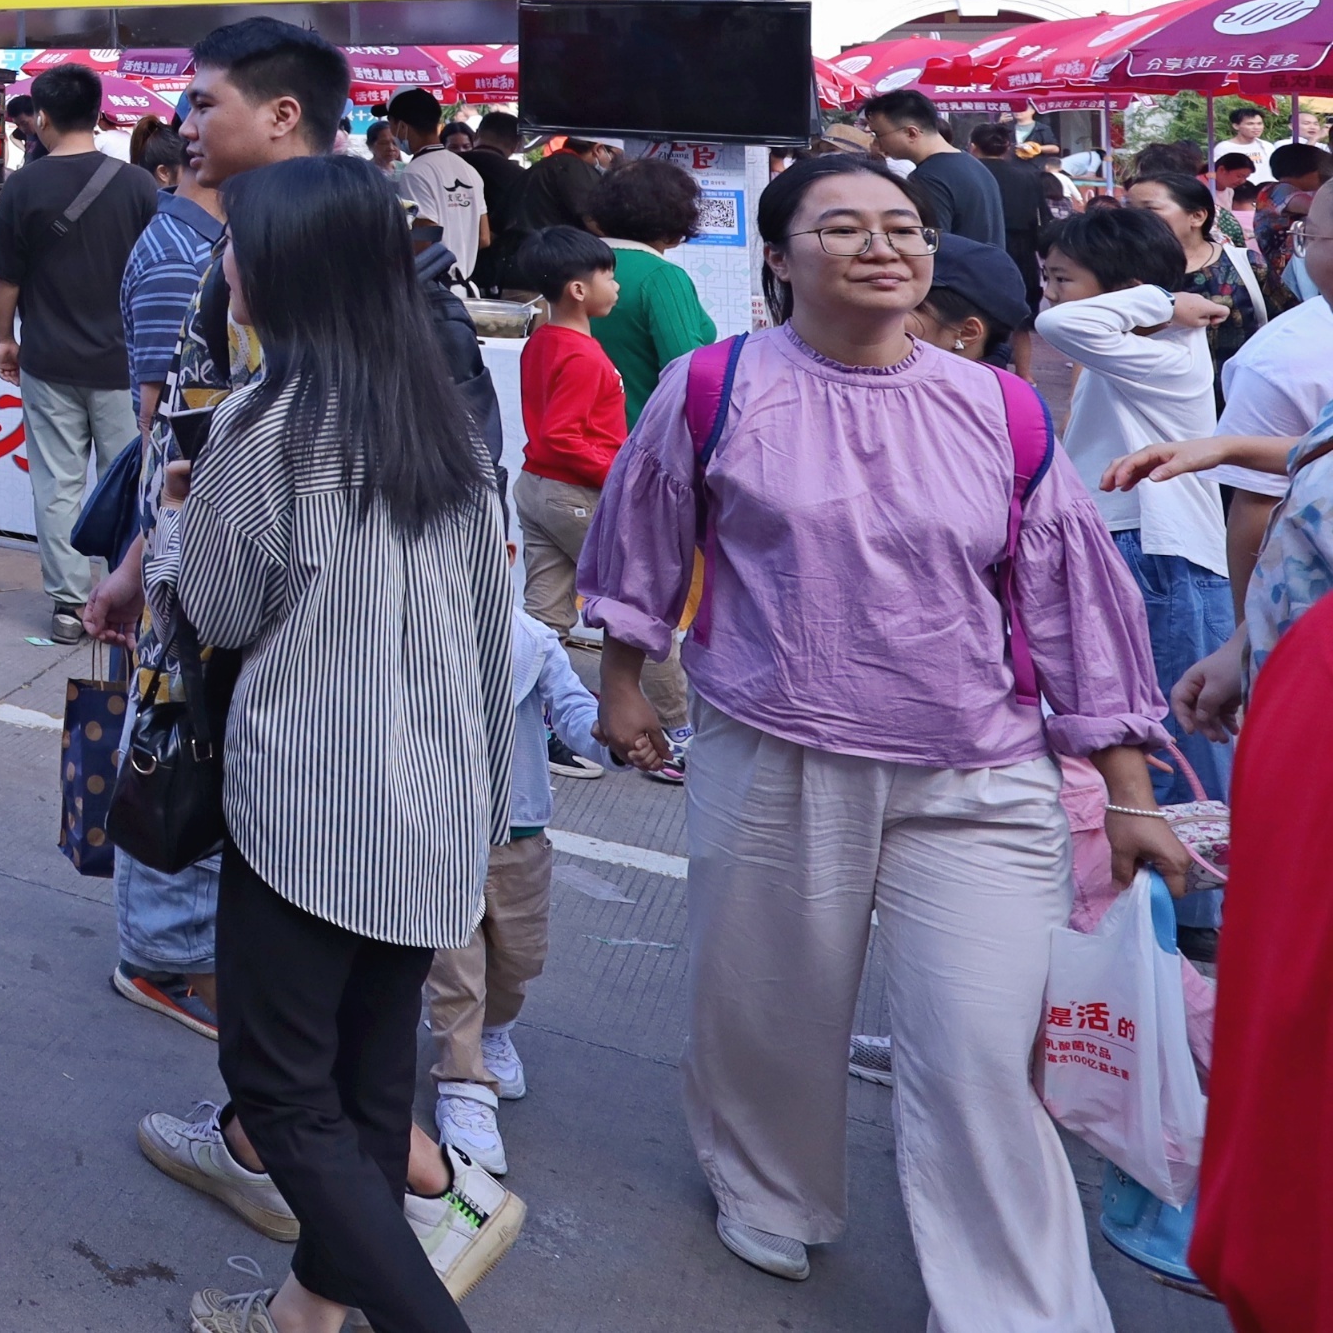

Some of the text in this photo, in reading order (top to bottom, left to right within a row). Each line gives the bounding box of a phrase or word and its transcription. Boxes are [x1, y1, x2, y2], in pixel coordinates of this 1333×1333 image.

[353, 67, 430, 83] 活性乳酸菌饮品
[935, 101, 1012, 113] 性乳酸菌饮品
